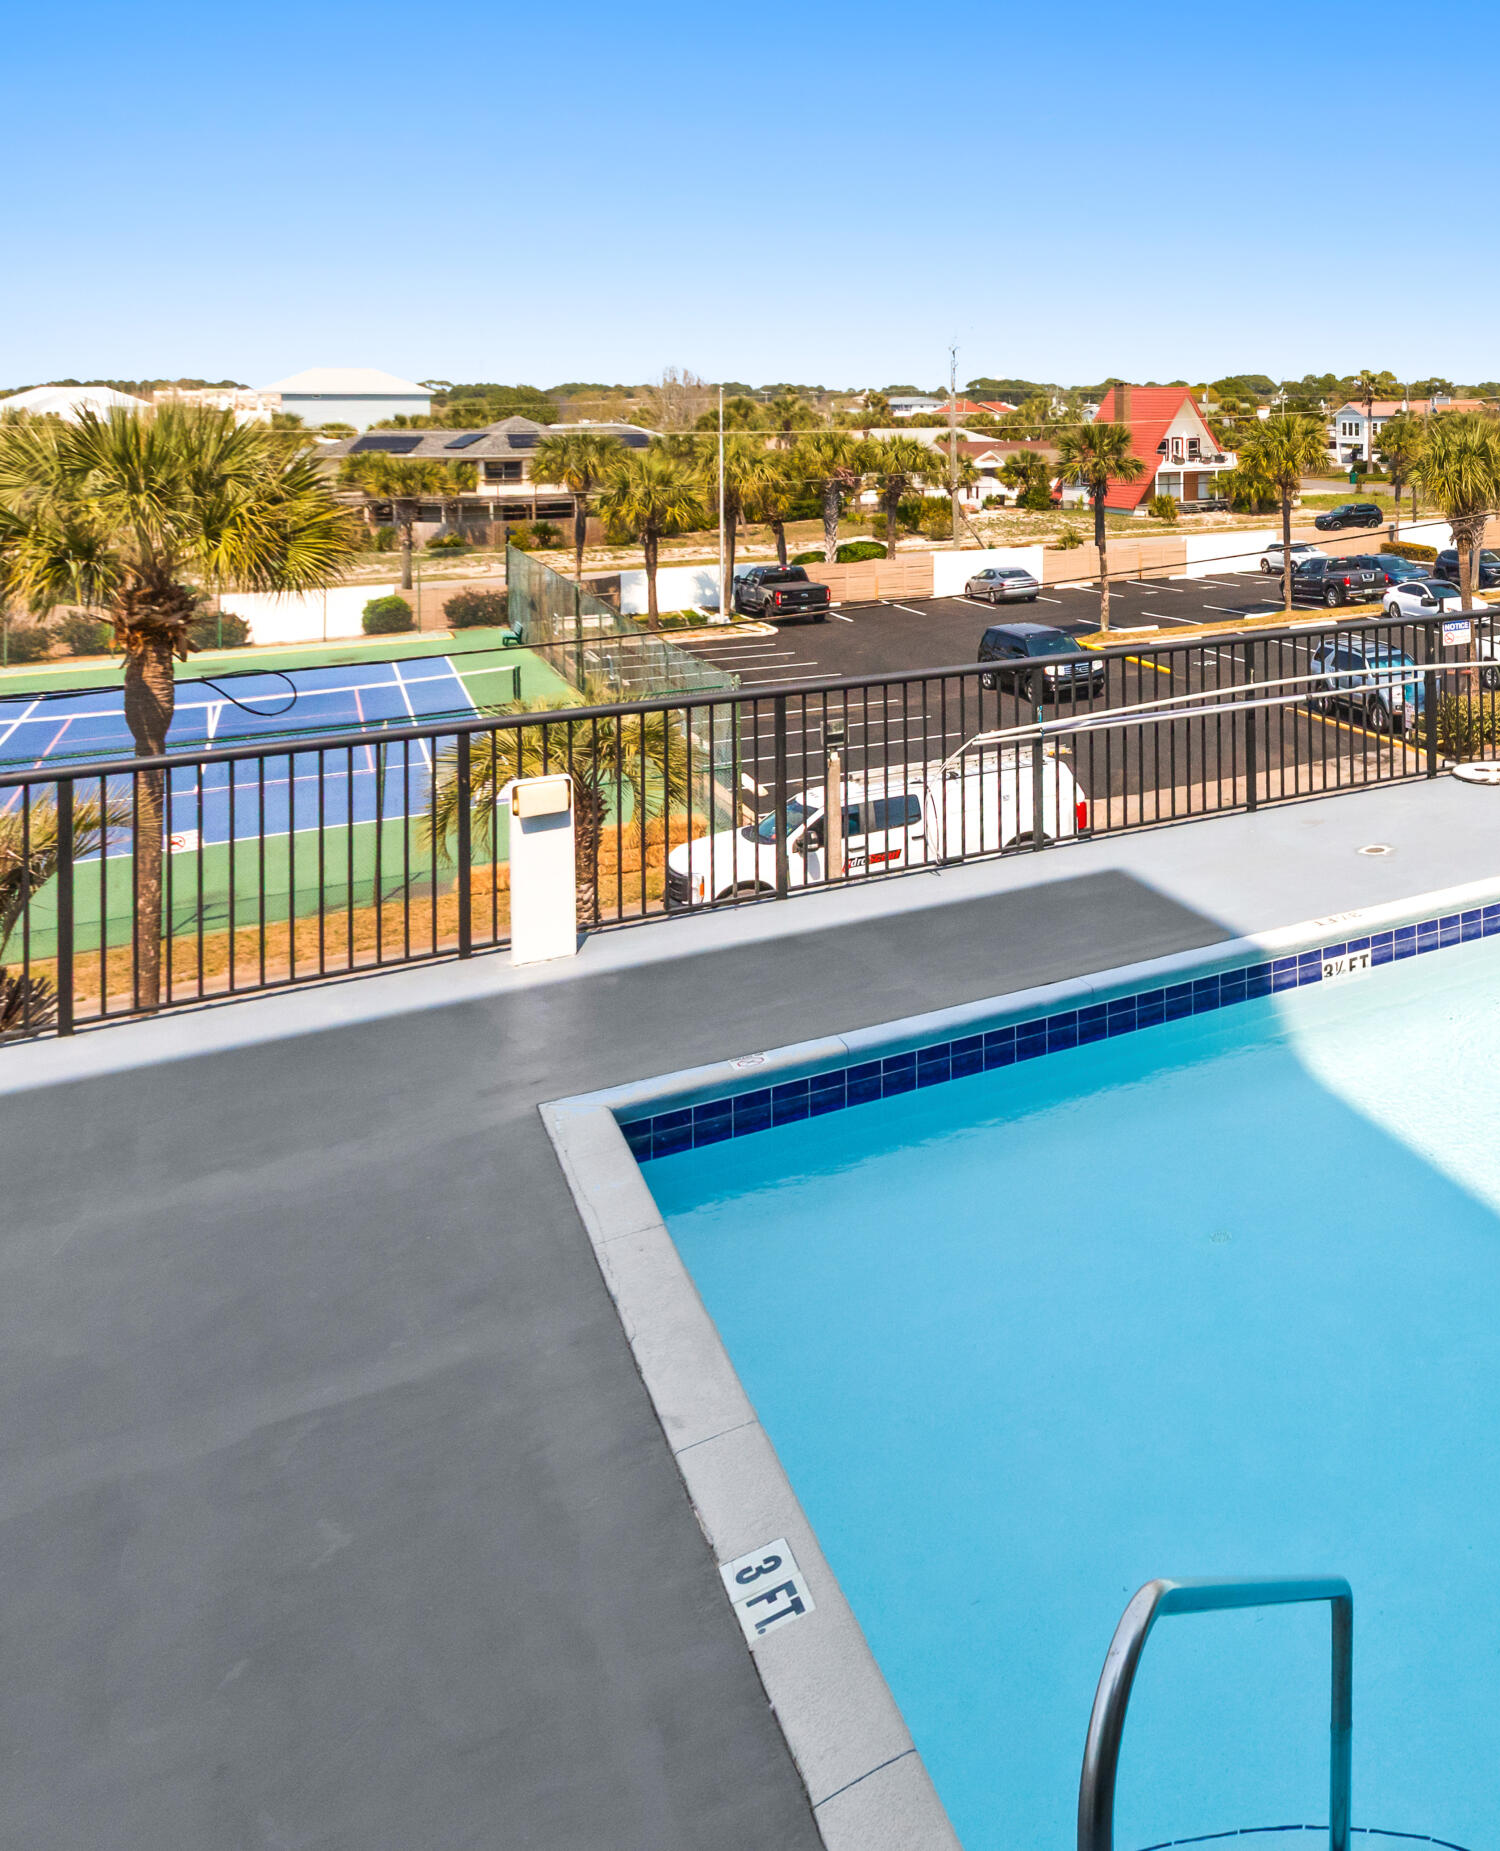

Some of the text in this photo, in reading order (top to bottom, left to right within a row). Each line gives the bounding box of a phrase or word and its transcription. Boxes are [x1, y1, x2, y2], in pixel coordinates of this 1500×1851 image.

[1444, 621, 1469, 630] NOTICE
[1349, 953, 1369, 972] FT
[735, 1555, 806, 1635] 3 FT.
